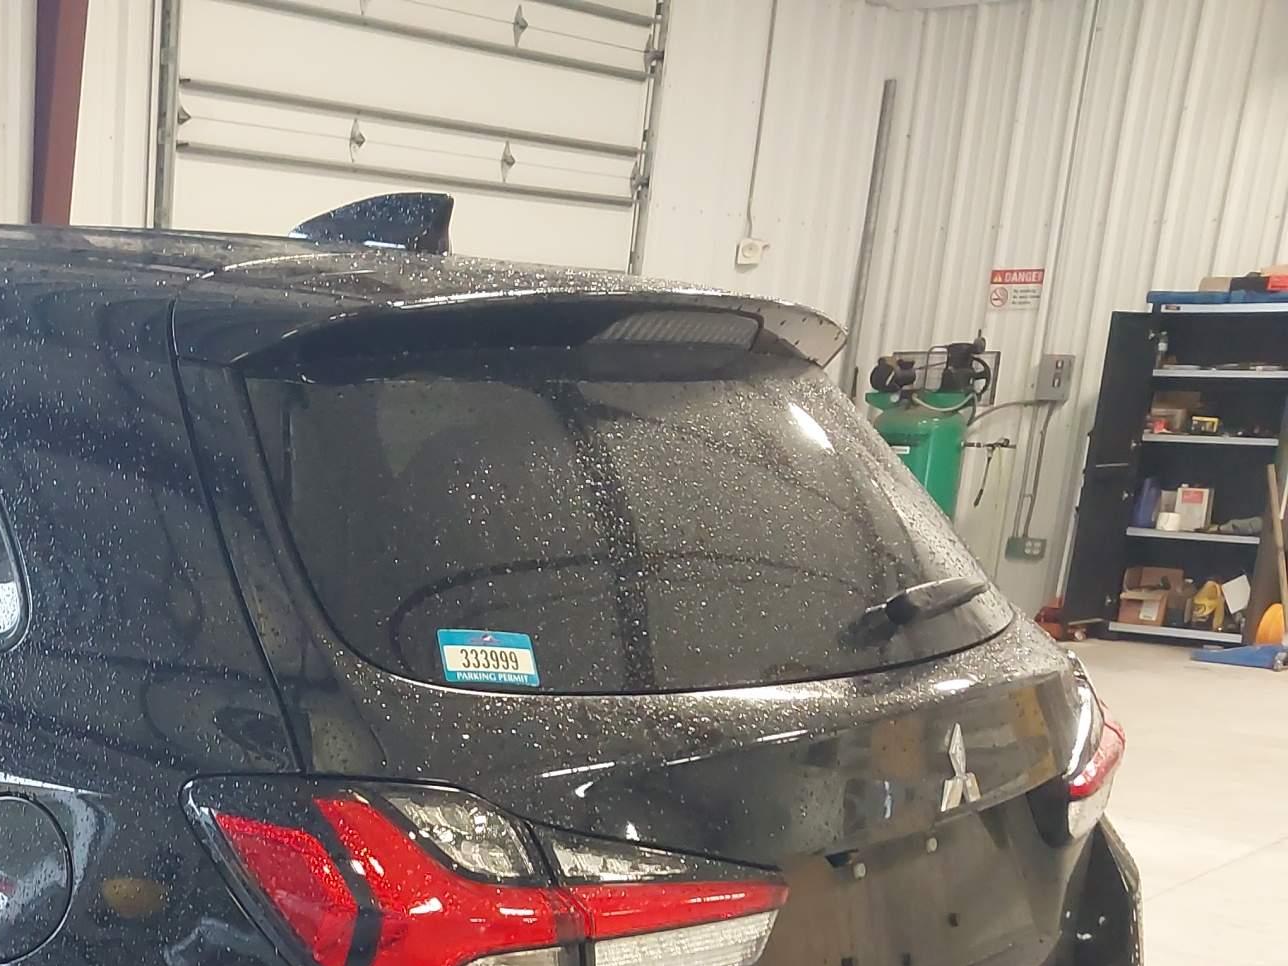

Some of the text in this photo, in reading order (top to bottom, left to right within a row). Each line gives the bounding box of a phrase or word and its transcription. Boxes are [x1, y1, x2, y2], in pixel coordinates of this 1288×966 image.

[460, 649, 519, 671] 333999
[456, 671, 529, 684] PARKING PERMIT
